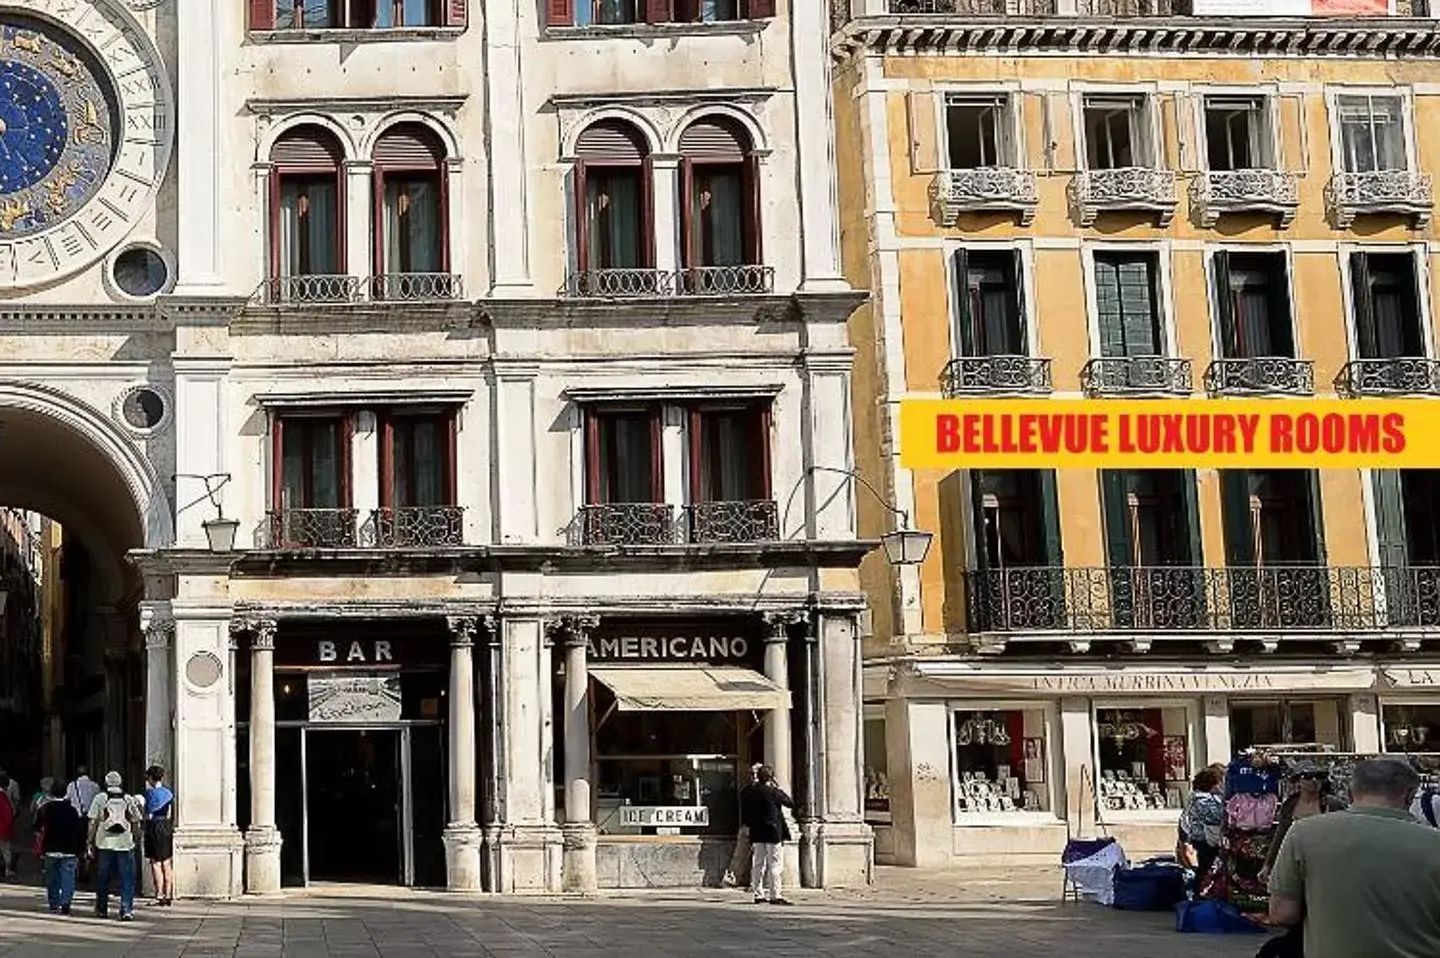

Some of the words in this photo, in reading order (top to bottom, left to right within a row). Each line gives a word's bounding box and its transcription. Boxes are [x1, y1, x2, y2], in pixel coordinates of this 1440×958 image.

[319, 641, 393, 661] BAR
[586, 637, 748, 657] AMERICANO
[623, 809, 646, 823] ICE
[655, 809, 705, 823] CREAM
